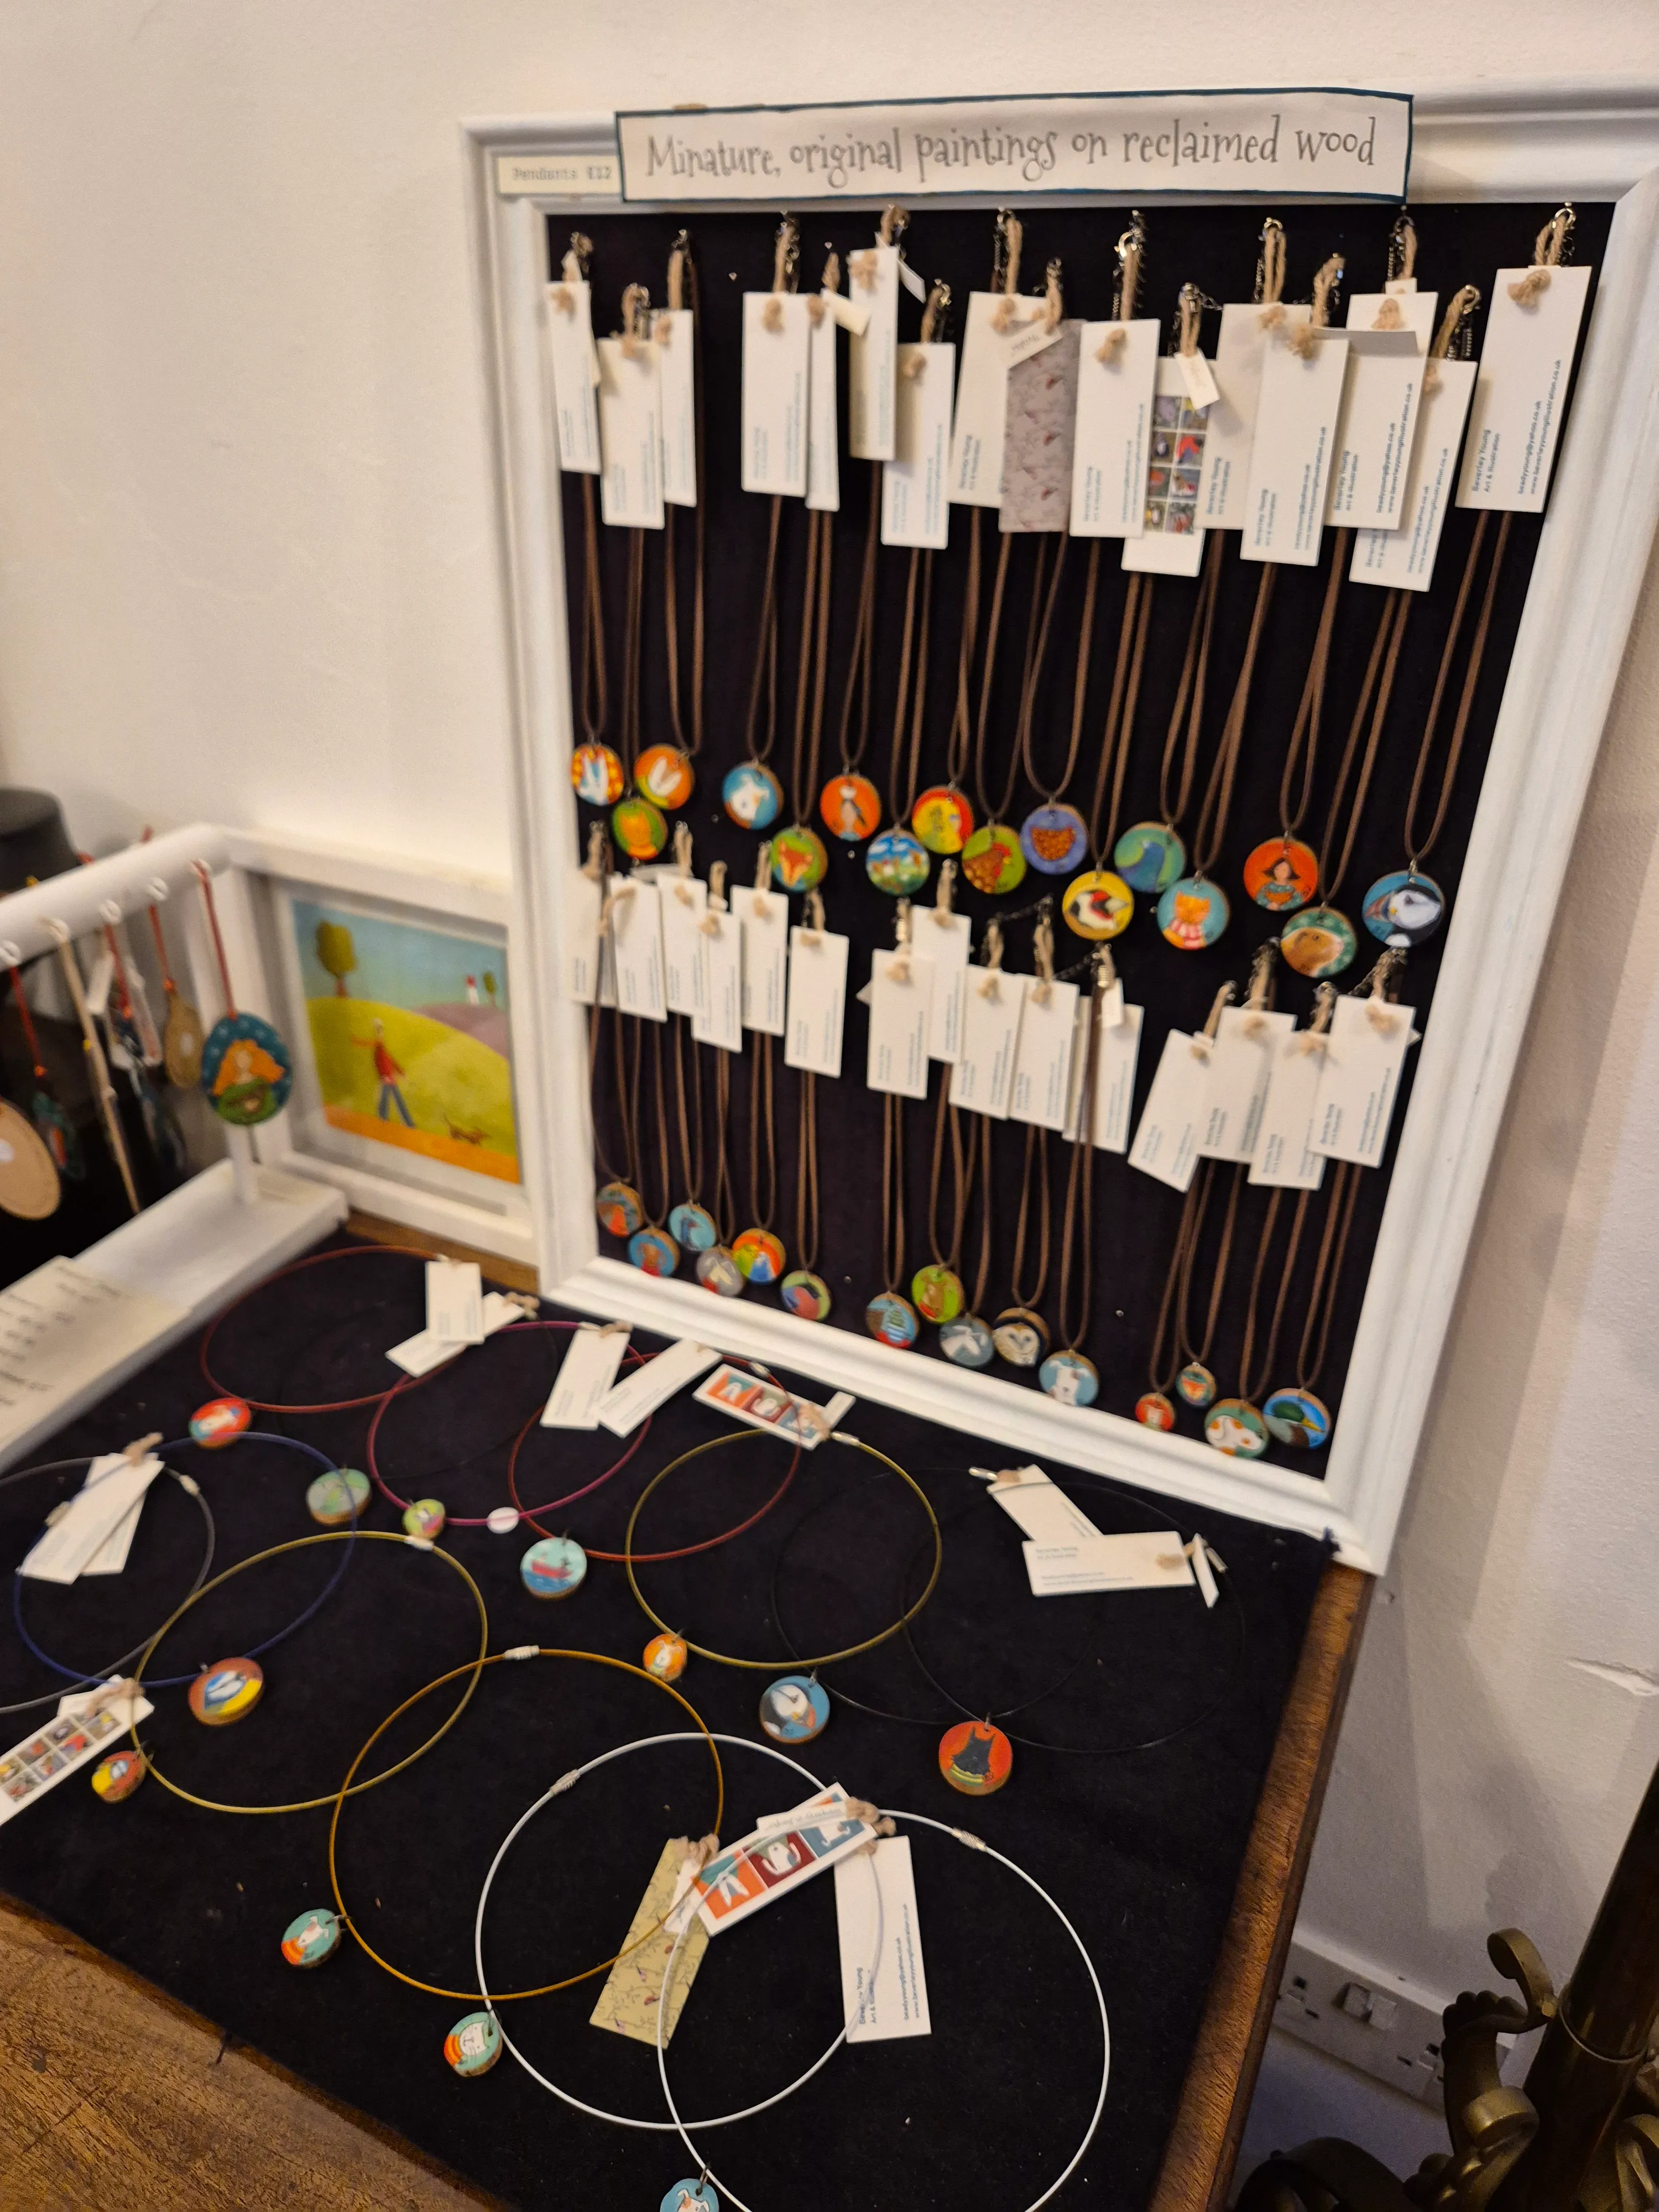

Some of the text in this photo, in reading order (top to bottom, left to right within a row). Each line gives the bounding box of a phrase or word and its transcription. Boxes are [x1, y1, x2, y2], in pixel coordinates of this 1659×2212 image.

[645, 113, 1376, 189] Minature, original paintings on reclaimed wood
[1472, 429, 1491, 492] Beverley Young
